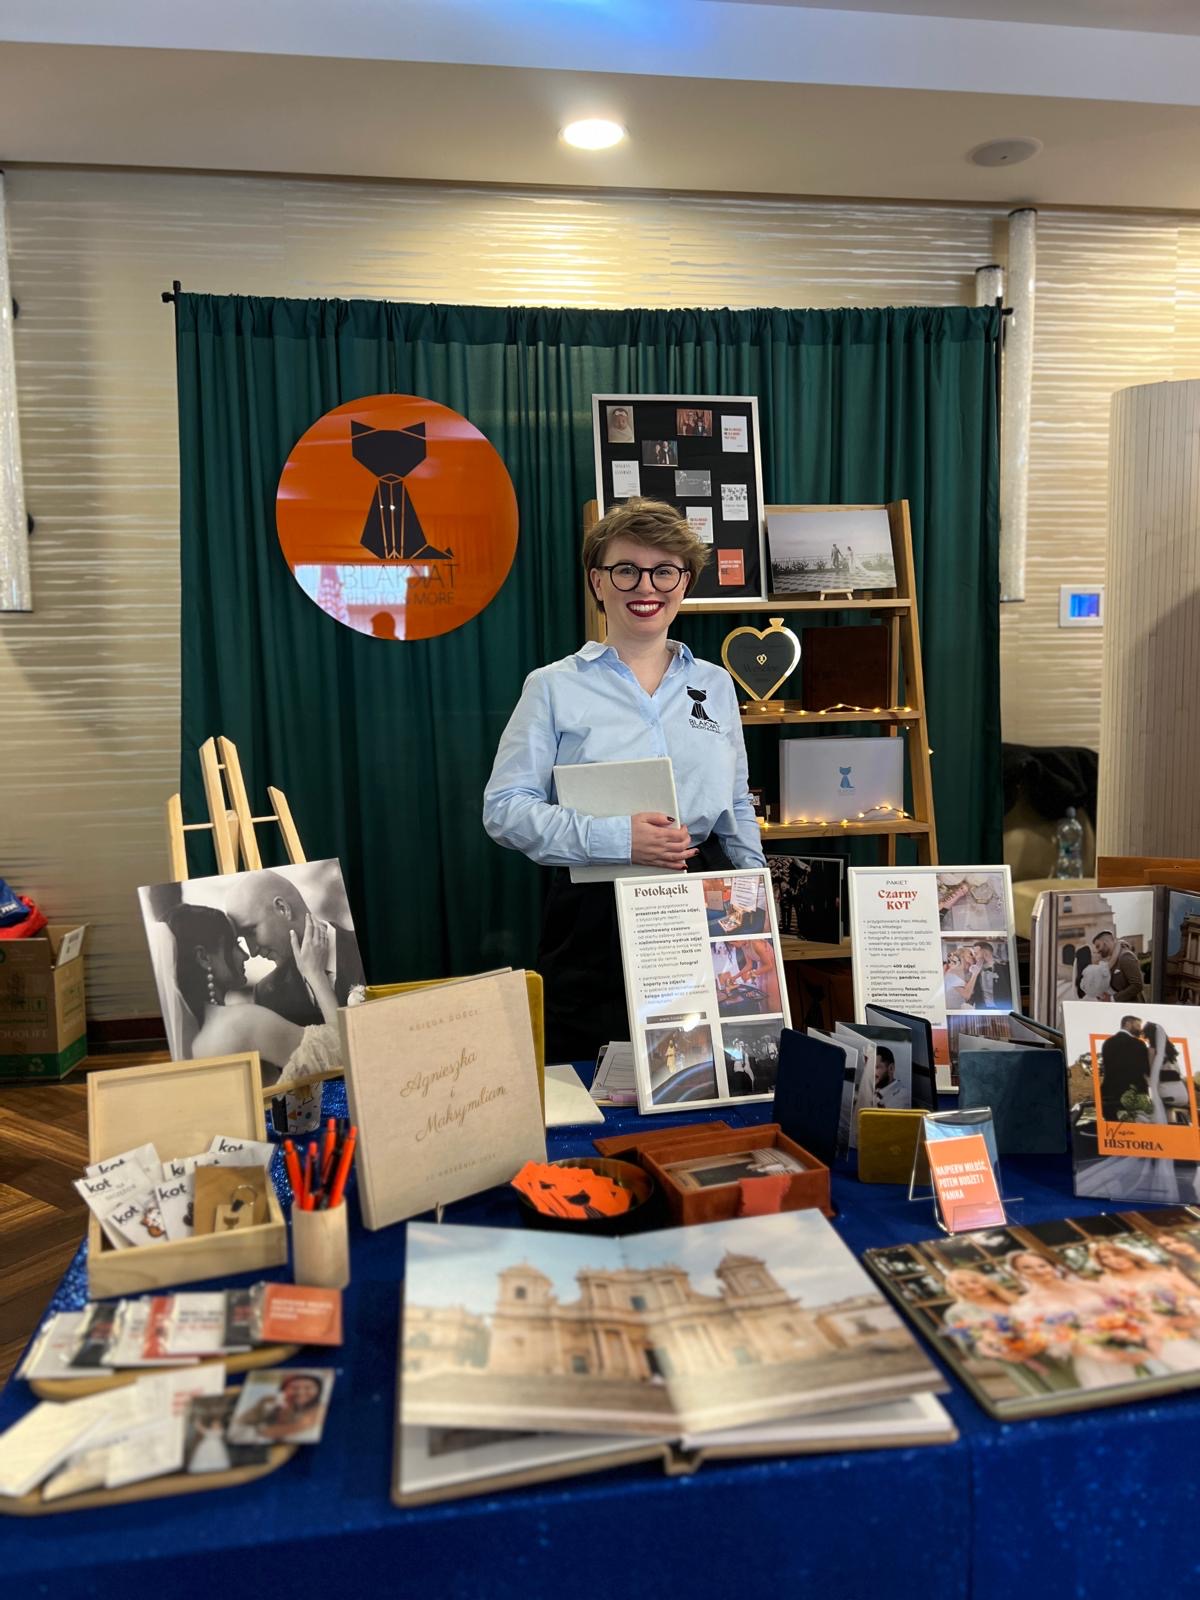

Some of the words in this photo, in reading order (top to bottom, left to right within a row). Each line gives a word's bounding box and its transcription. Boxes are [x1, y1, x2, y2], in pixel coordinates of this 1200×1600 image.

[634, 884, 688, 898] Fotokącik
[878, 890, 918, 902] Czarny
[887, 901, 910, 910] KOT
[400, 1048, 478, 1098] Agnieszka
[450, 1088, 456, 1098] i
[416, 1084, 507, 1142] Maksymilian
[1104, 1139, 1164, 1151] HISTORIA
[84, 1178, 112, 1193] kot
[158, 1184, 187, 1200] kot
[112, 1205, 140, 1224] kot
